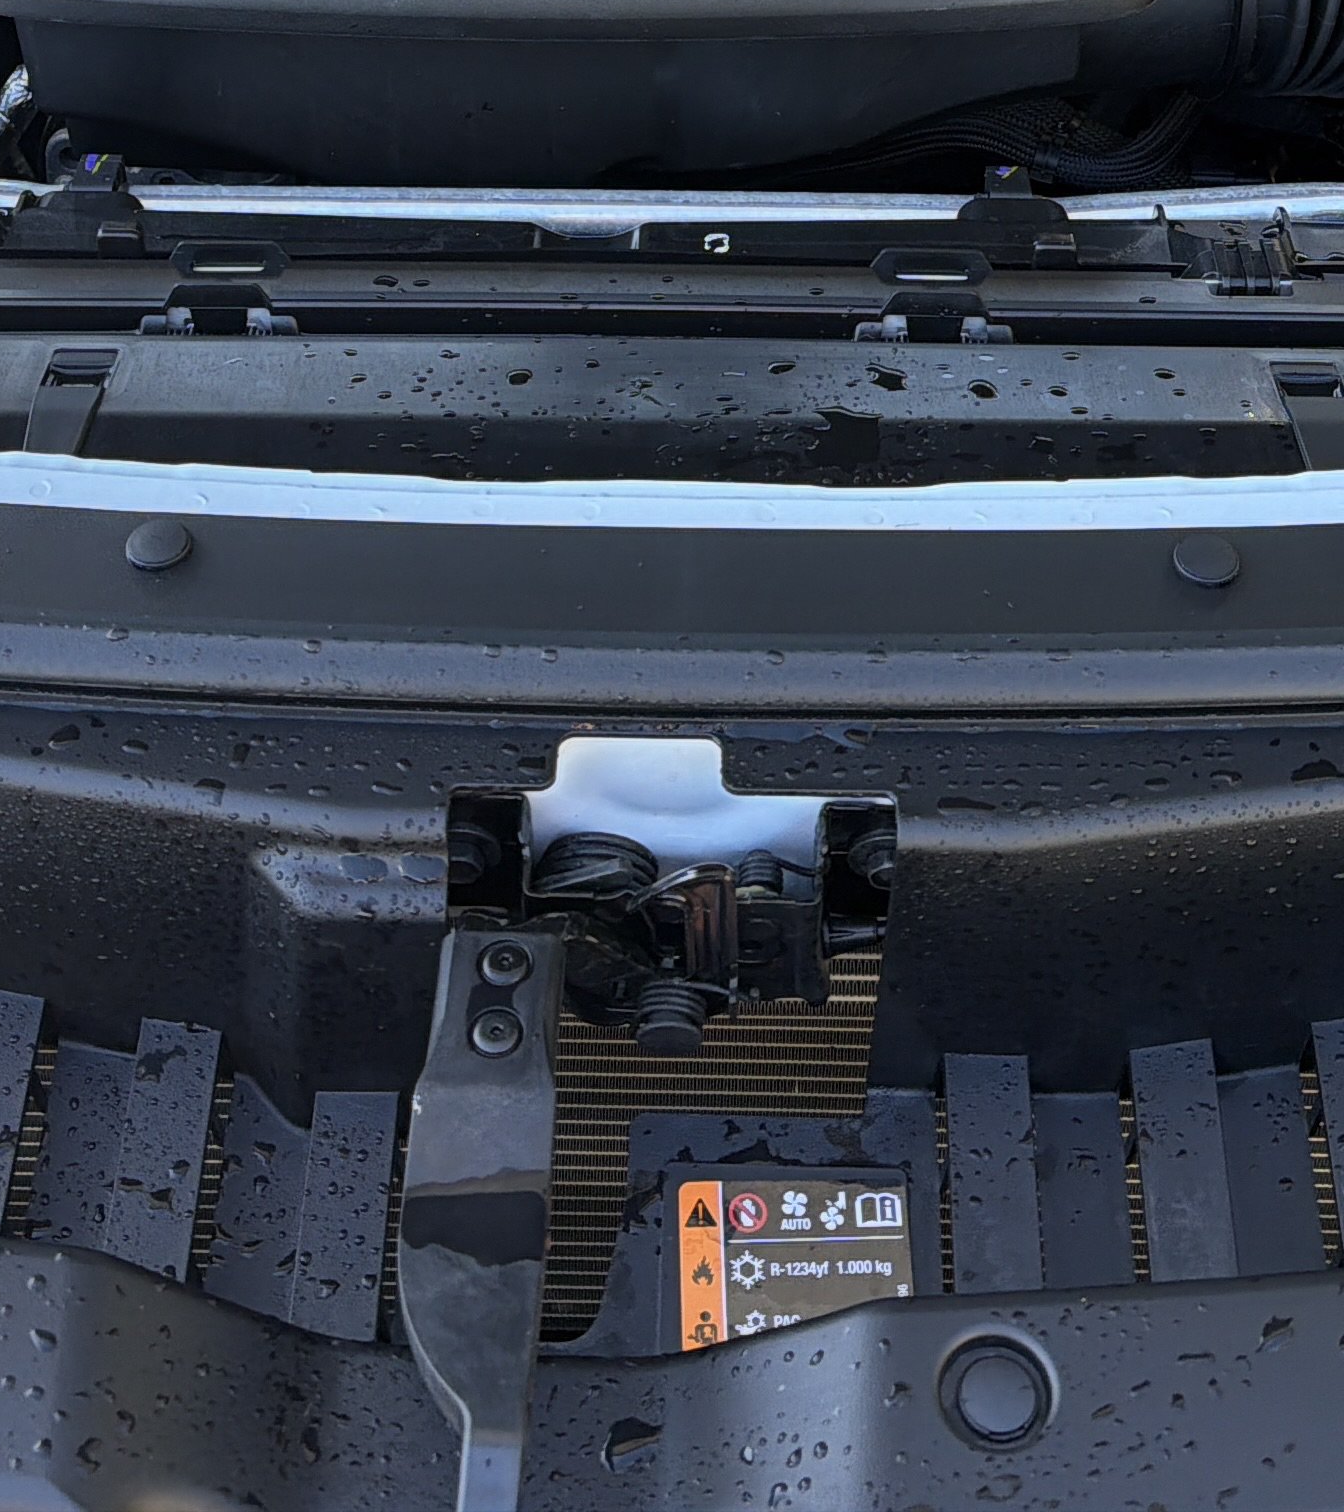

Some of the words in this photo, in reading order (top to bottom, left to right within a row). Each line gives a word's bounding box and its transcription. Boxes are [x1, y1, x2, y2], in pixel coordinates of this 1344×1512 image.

[780, 1218, 812, 1231] AUTO
[770, 1260, 829, 1278] R-1234yf
[836, 1260, 872, 1275] 1.000
[875, 1259, 892, 1276] kg
